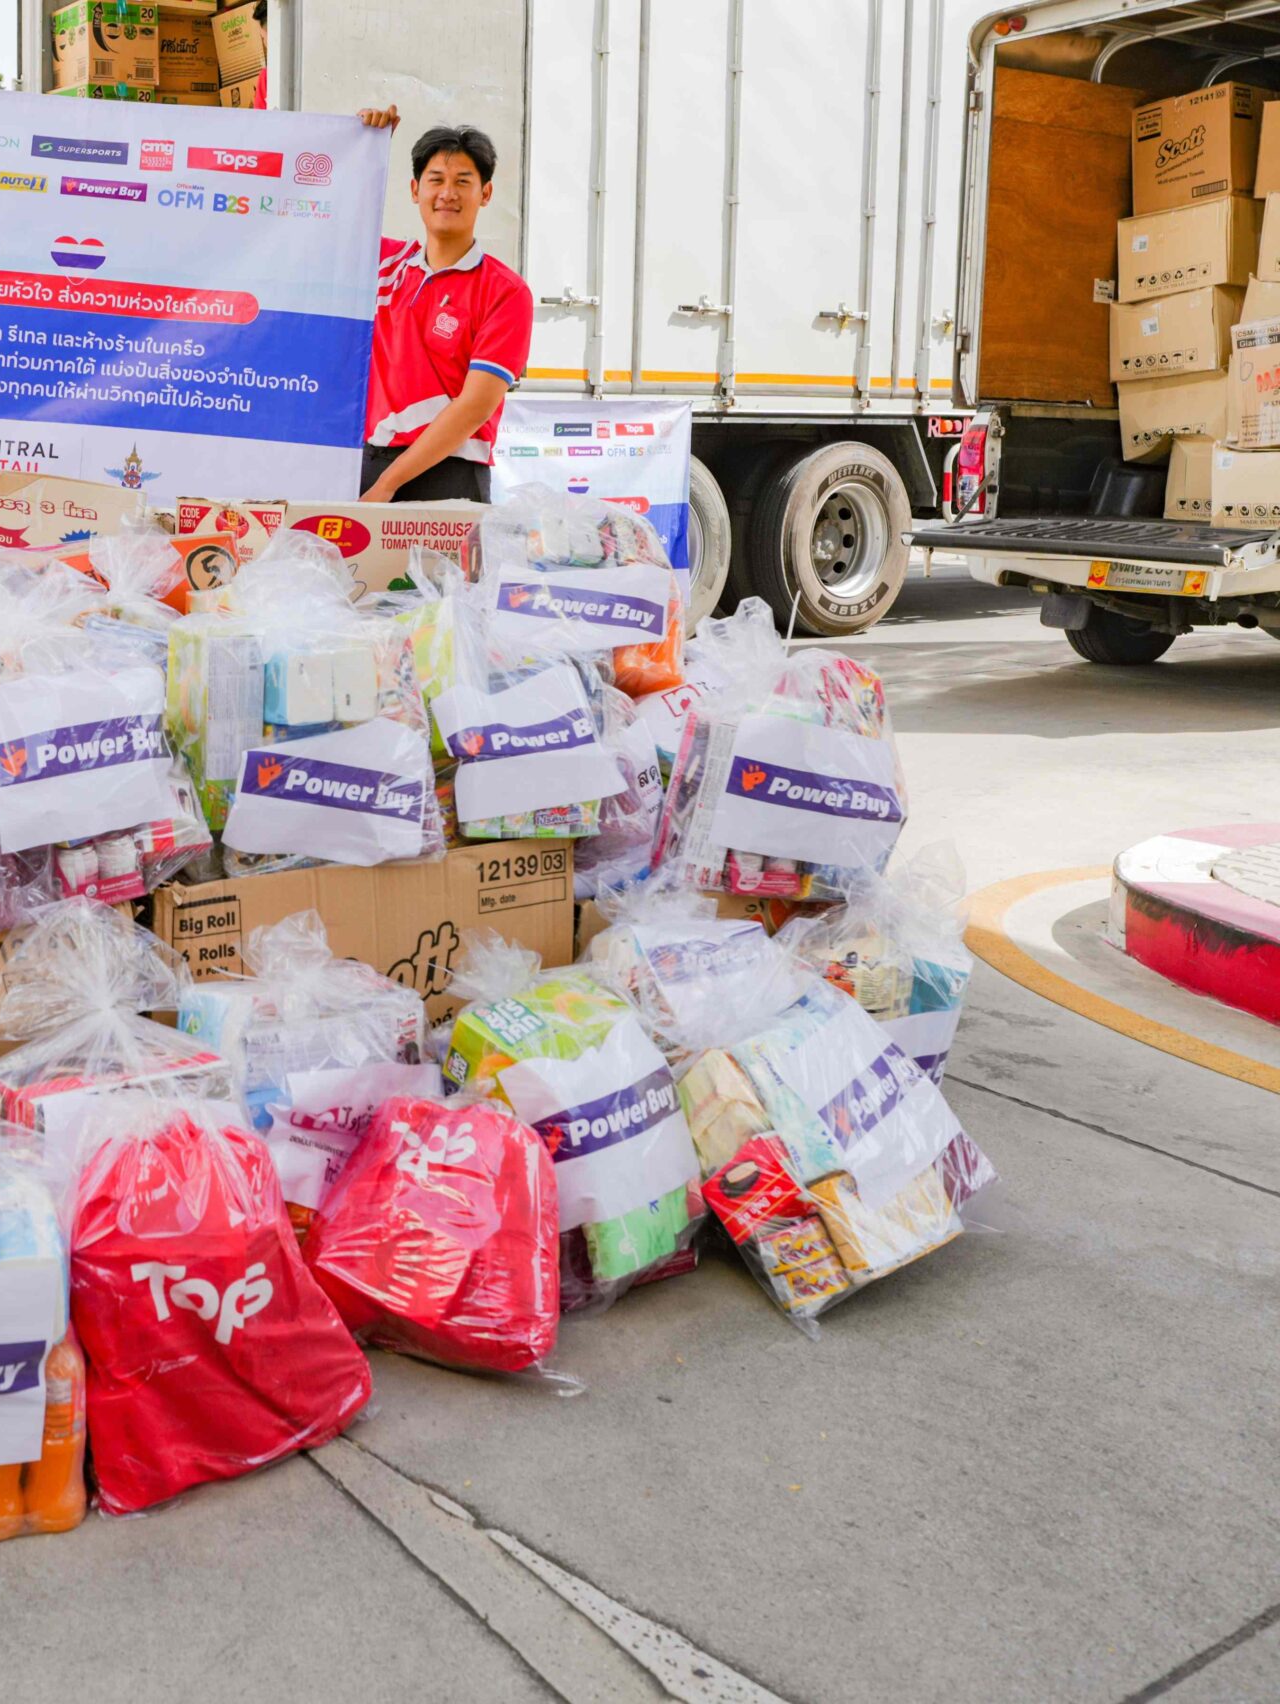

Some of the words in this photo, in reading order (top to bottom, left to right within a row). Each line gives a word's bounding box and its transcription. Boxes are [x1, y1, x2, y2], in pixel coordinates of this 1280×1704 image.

[142, 8, 154, 19] 20
[57, 145, 122, 157] SUPERSPORTS
[1155, 125, 1207, 168] Scott
[212, 150, 257, 170] Tops
[78, 182, 118, 195] Power
[119, 185, 142, 200] Buy
[157, 189, 204, 210] OFM
[213, 193, 250, 215] B2S
[58, 283, 234, 317] ส่งความห่วงใยถึงกัน
[7, 325, 47, 345] รีเทล
[52, 330, 205, 357] และห้างร้านในเครือ
[101, 358, 319, 393] แบ่งปันสิ่งของจำเป็นจากใจ
[828, 465, 876, 485] WESTLAKE
[40, 500, 55, 514] 3
[63, 501, 97, 520] โหล
[180, 507, 200, 518] CODE
[262, 513, 280, 525] CODE
[323, 521, 338, 536] FF
[532, 593, 610, 620] Power
[610, 602, 655, 628] Buy
[491, 727, 570, 751] Power
[37, 735, 127, 769] Power
[284, 768, 374, 804] Power
[375, 780, 418, 822] Buy
[767, 776, 846, 807] Power
[849, 790, 891, 818] Buy
[476, 855, 538, 882] 12139
[543, 854, 563, 871] 03
[499, 894, 516, 904] date
[179, 917, 203, 934] Big
[207, 911, 236, 929] Roll
[199, 943, 236, 962] Rolls
[569, 1104, 647, 1147] Power
[647, 1082, 676, 1115] Buy
[130, 1262, 274, 1345] Tops
